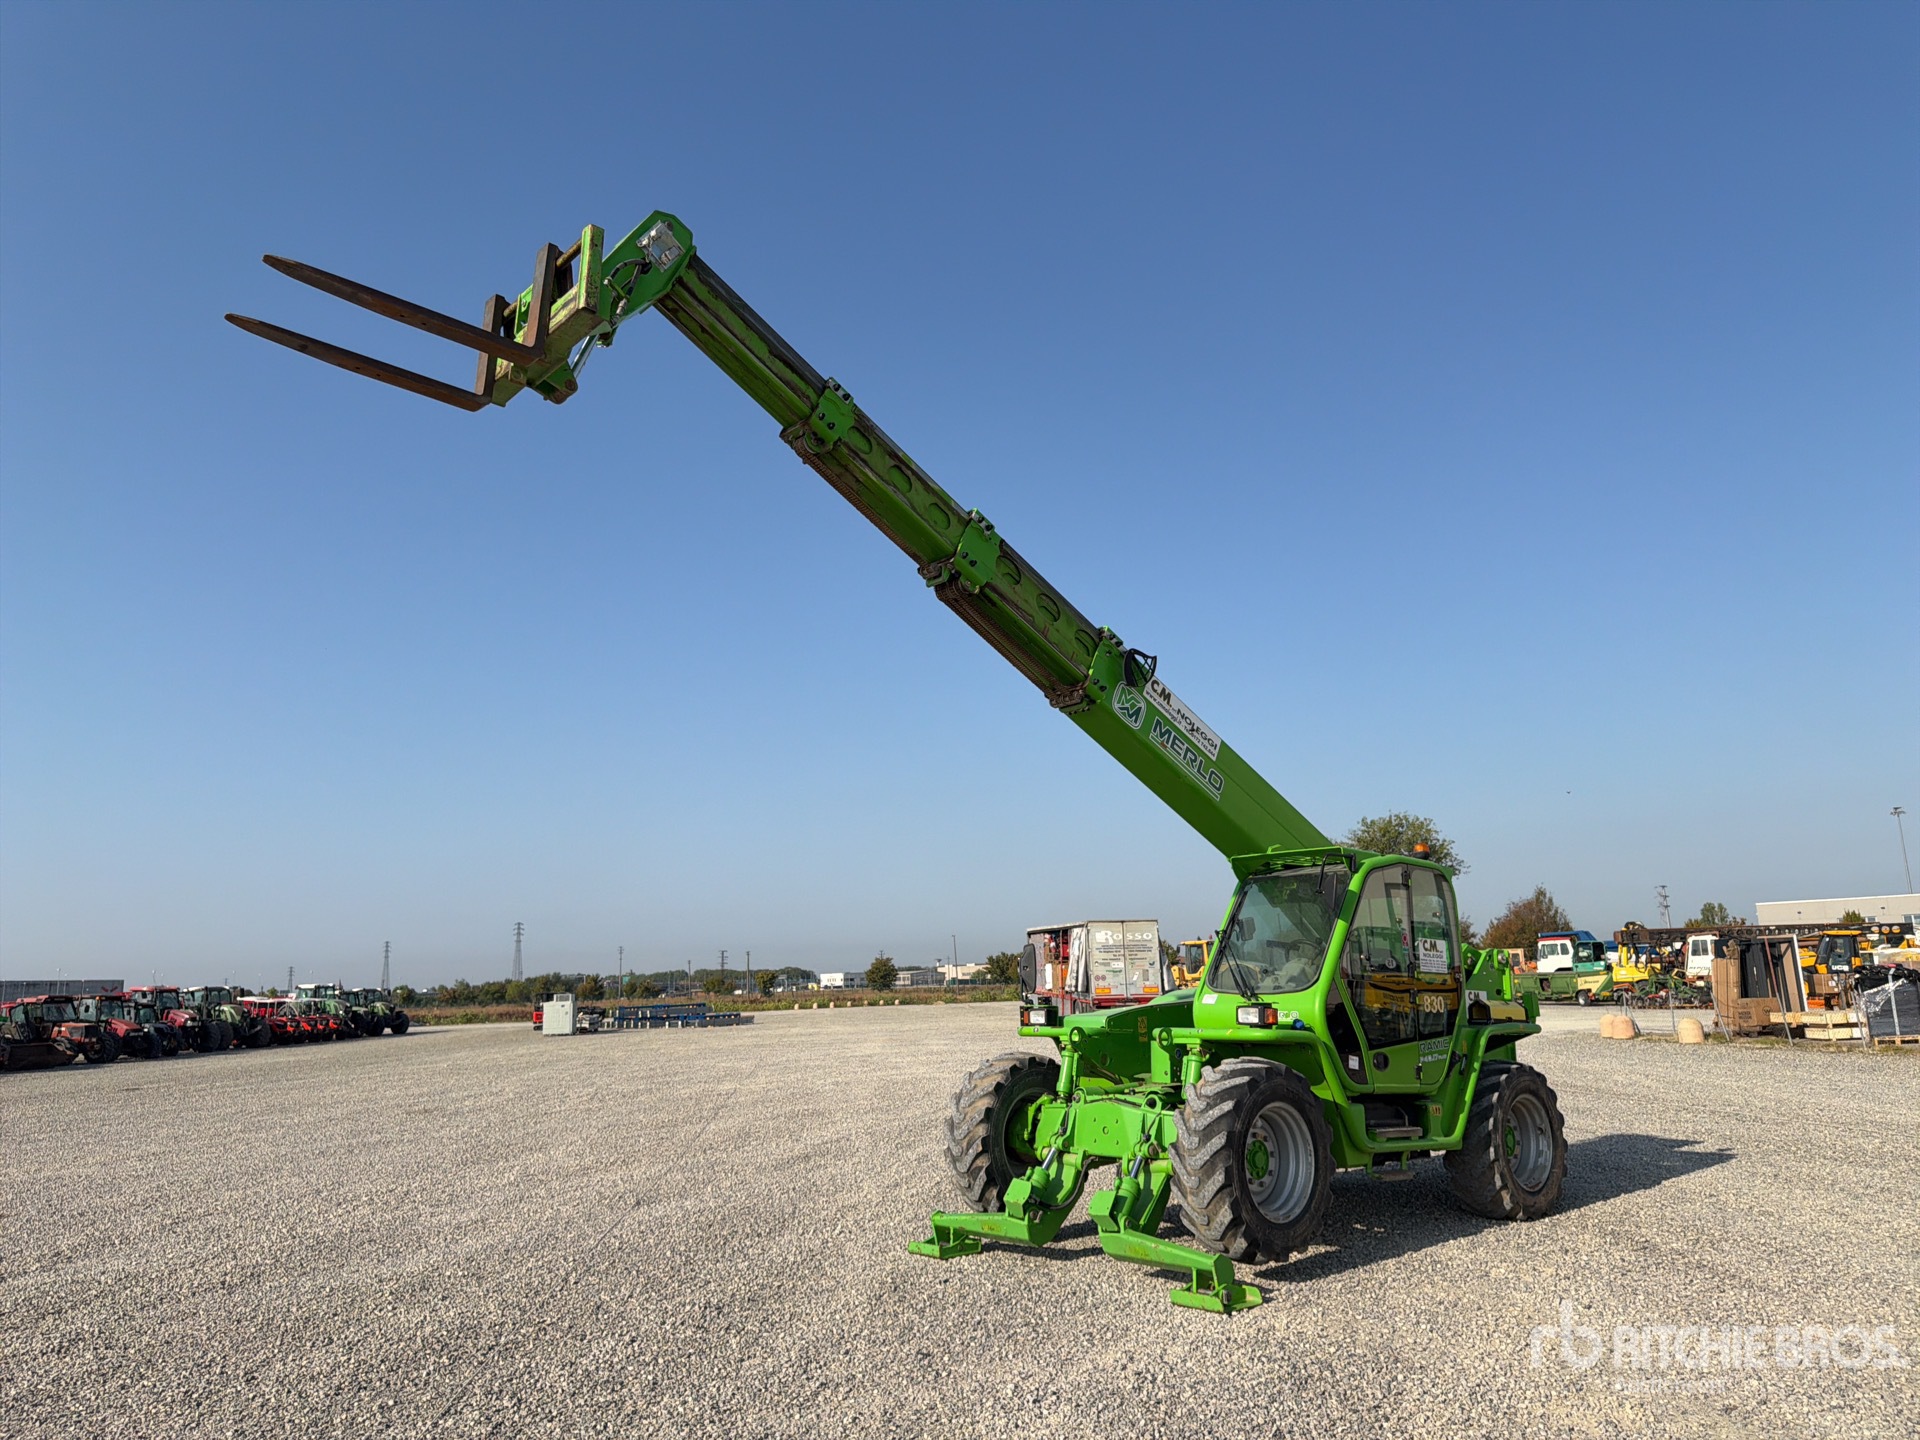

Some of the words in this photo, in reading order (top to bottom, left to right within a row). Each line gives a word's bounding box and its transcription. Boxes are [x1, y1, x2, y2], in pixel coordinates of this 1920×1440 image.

[1151, 679, 1172, 707] C.M.
[1177, 708, 1218, 751] NOLEGGI
[1152, 718, 1223, 792] MERLO
[1424, 995, 1444, 1013] 830
